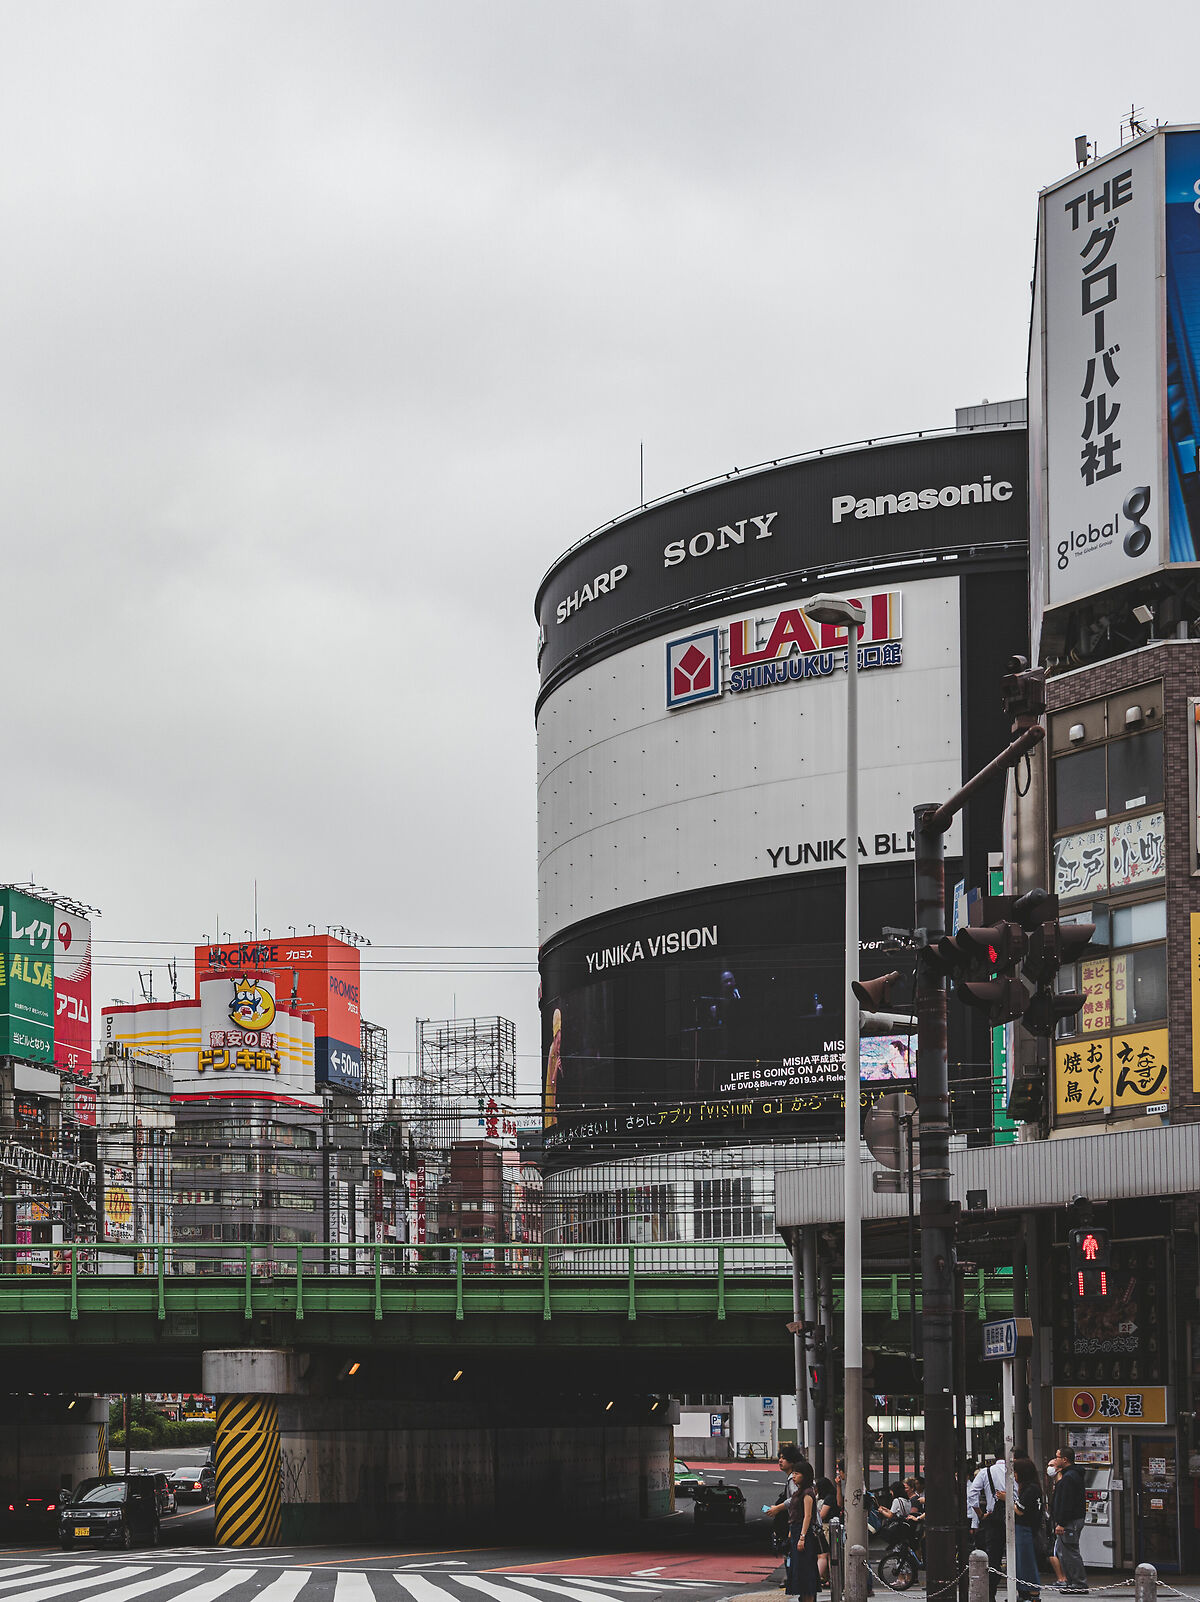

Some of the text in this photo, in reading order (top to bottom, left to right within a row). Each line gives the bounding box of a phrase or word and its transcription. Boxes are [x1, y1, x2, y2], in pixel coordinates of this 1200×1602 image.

[1065, 168, 1133, 232] THE
[1079, 216, 1122, 486] グローバル社
[831, 475, 1014, 523] Panasonic
[664, 511, 778, 568] SONY
[1057, 512, 1119, 570] global
[556, 563, 629, 625] SHARP
[730, 652, 834, 693] SHINJUKU
[766, 831, 948, 868] YUNIKA BLD.
[11, 910, 52, 950] レイク
[208, 945, 279, 967] PROMISE
[286, 949, 313, 961] プロミス
[585, 924, 718, 974] YUNIKA VISION
[10, 953, 52, 990] ALSA
[330, 975, 359, 1003] PROMISE
[56, 992, 89, 1024] アコム
[67, 1053, 78, 1069] 3F
[340, 1052, 360, 1077] 50m
[731, 1063, 838, 1081] LIFE IS GOING ON AND
[1063, 1051, 1083, 1103] 焼鳥
[1086, 1043, 1104, 1106] おでん
[720, 1083, 736, 1092] LIVE
[789, 1075, 824, 1085] 2019.9.4
[1121, 1323, 1133, 1332] 2F
[1098, 1393, 1143, 1417] 松屋
